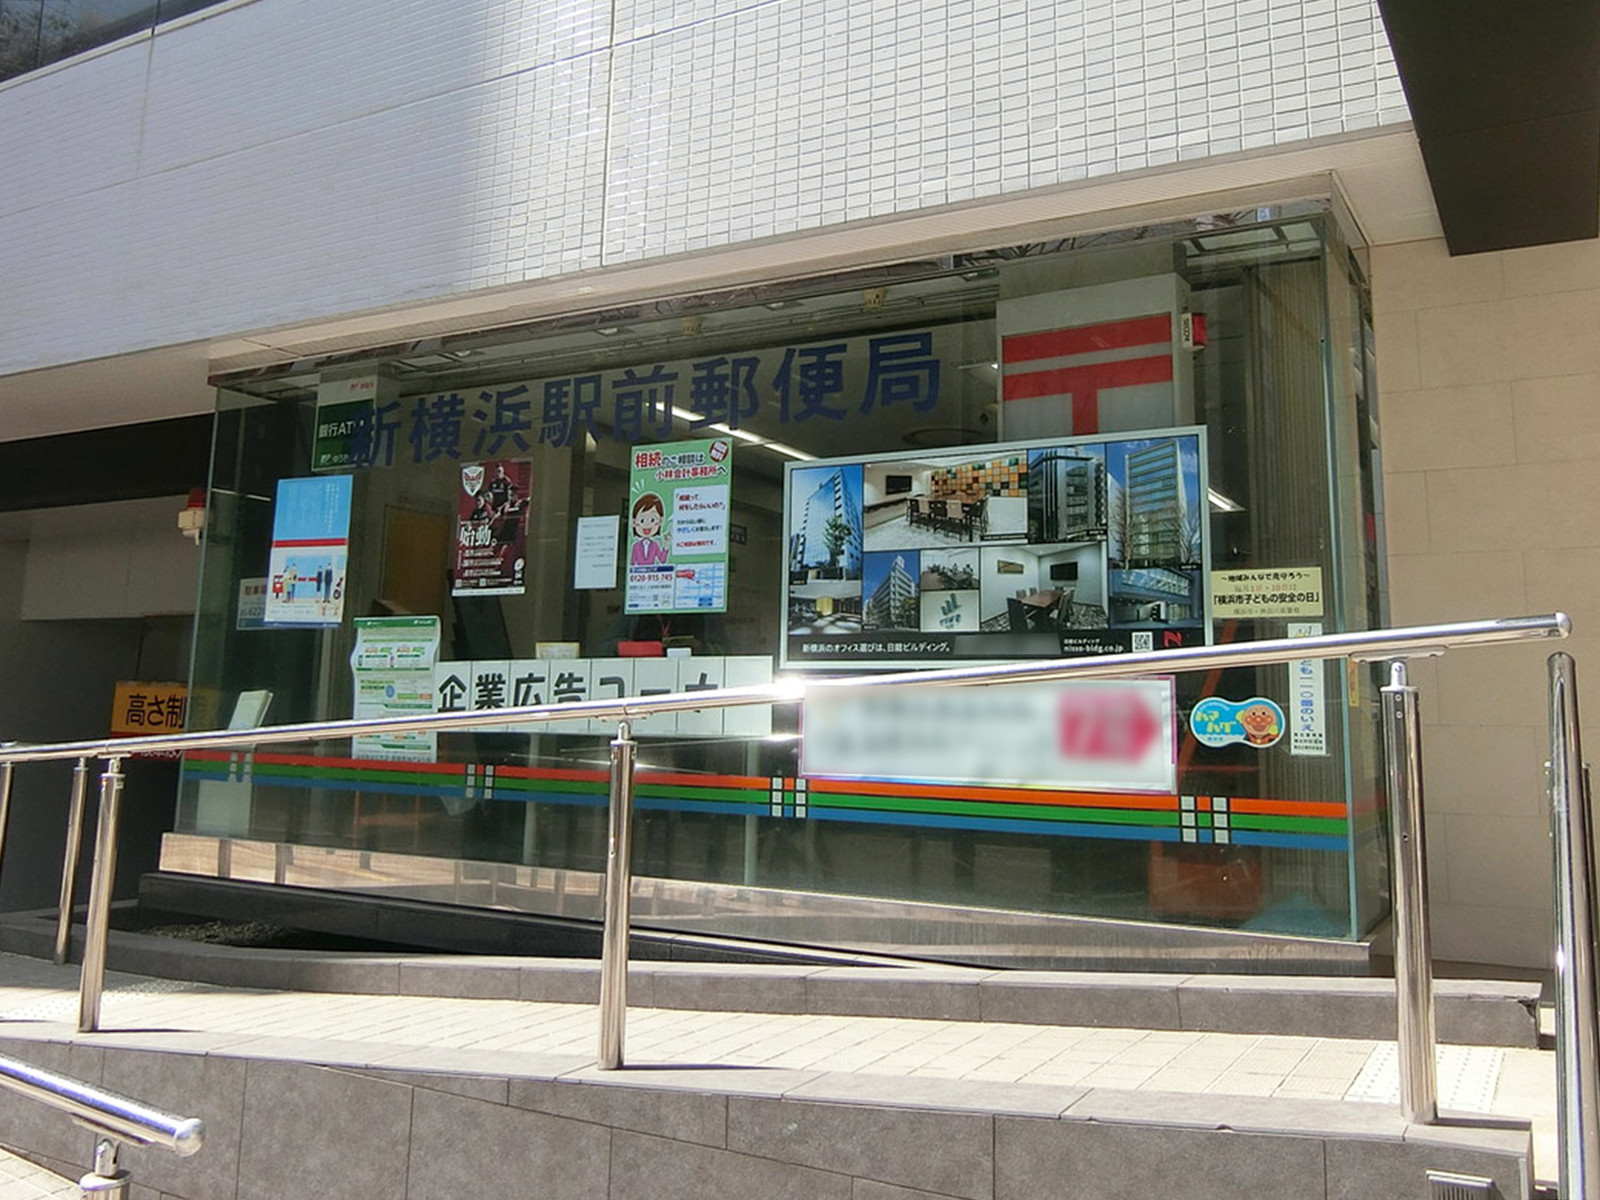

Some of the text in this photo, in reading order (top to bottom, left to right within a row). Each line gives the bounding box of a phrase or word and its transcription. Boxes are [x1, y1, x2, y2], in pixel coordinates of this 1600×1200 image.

[319, 420, 366, 438] 銀行AT
[350, 331, 941, 468] 新横浜駅前郵便局
